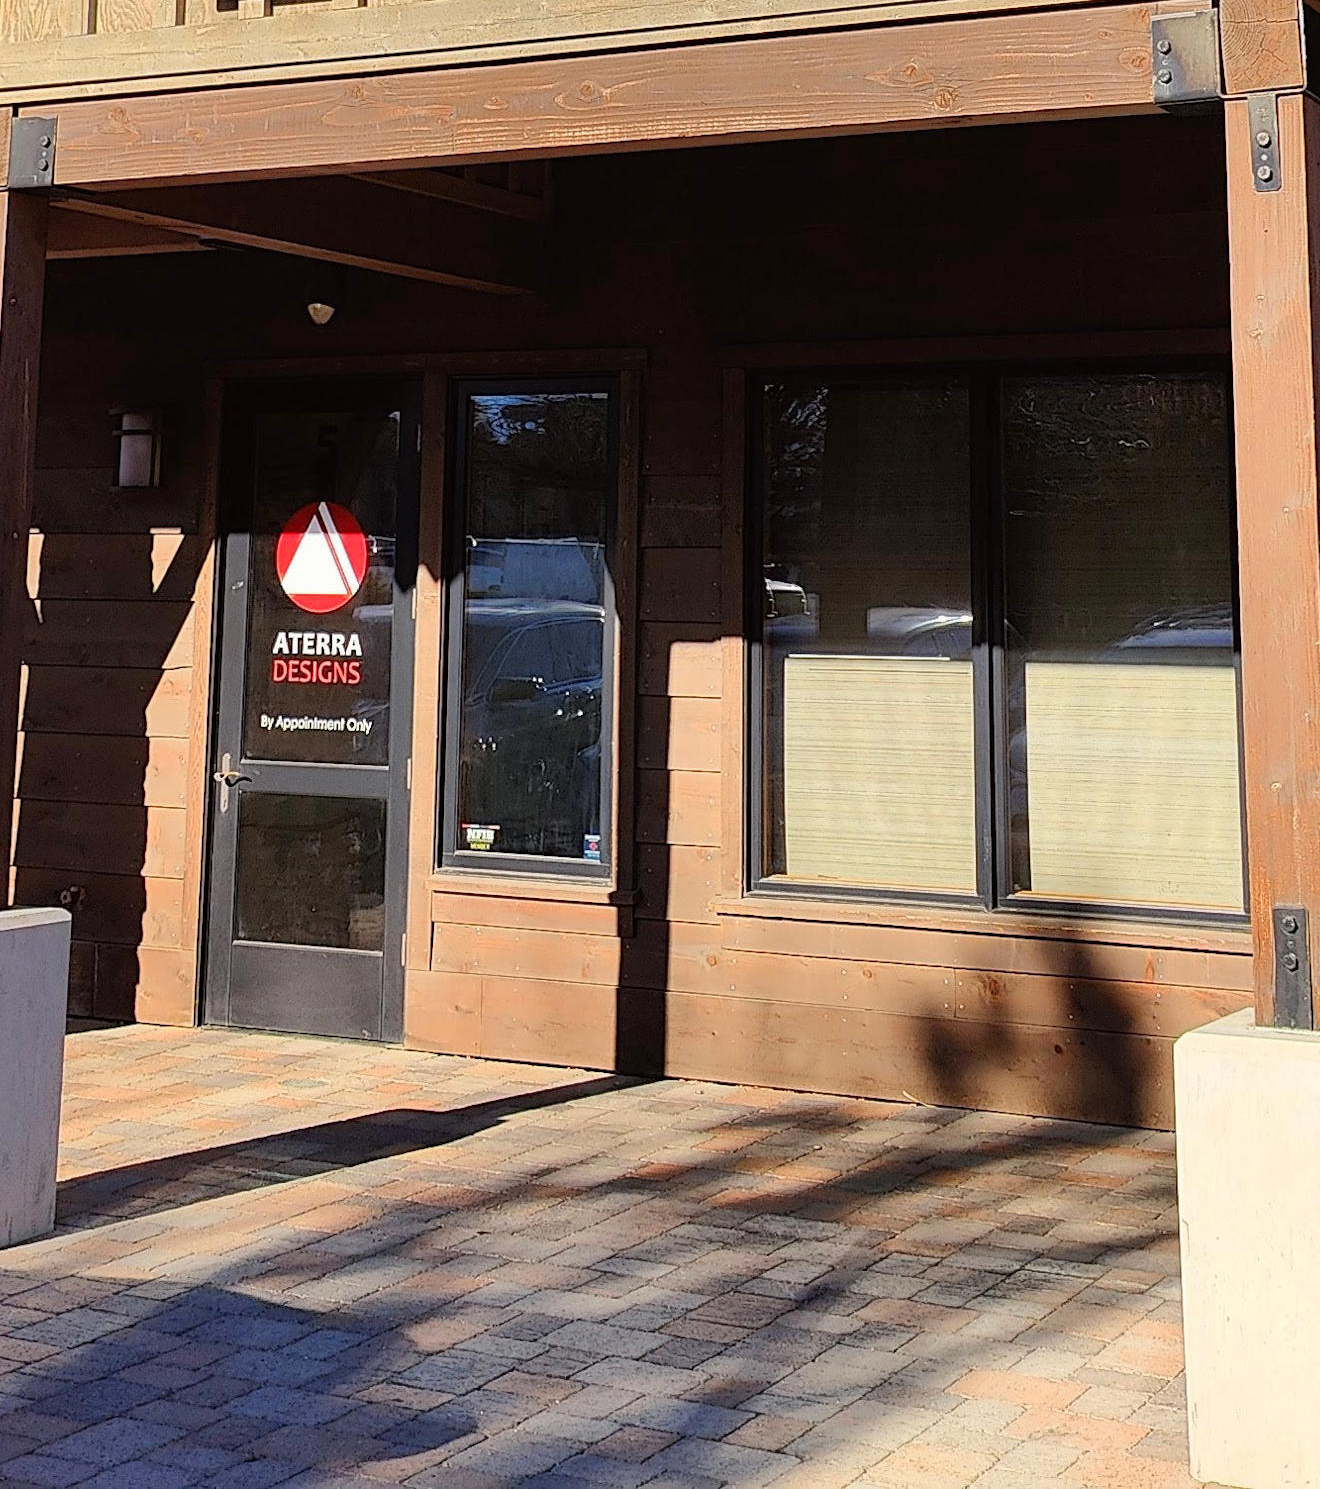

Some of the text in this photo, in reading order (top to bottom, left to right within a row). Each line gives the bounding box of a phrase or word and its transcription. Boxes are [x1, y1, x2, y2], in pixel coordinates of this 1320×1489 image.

[272, 631, 363, 657] ATERRA
[272, 659, 362, 685] DESIGNS
[260, 714, 373, 735] By Appointment Only
